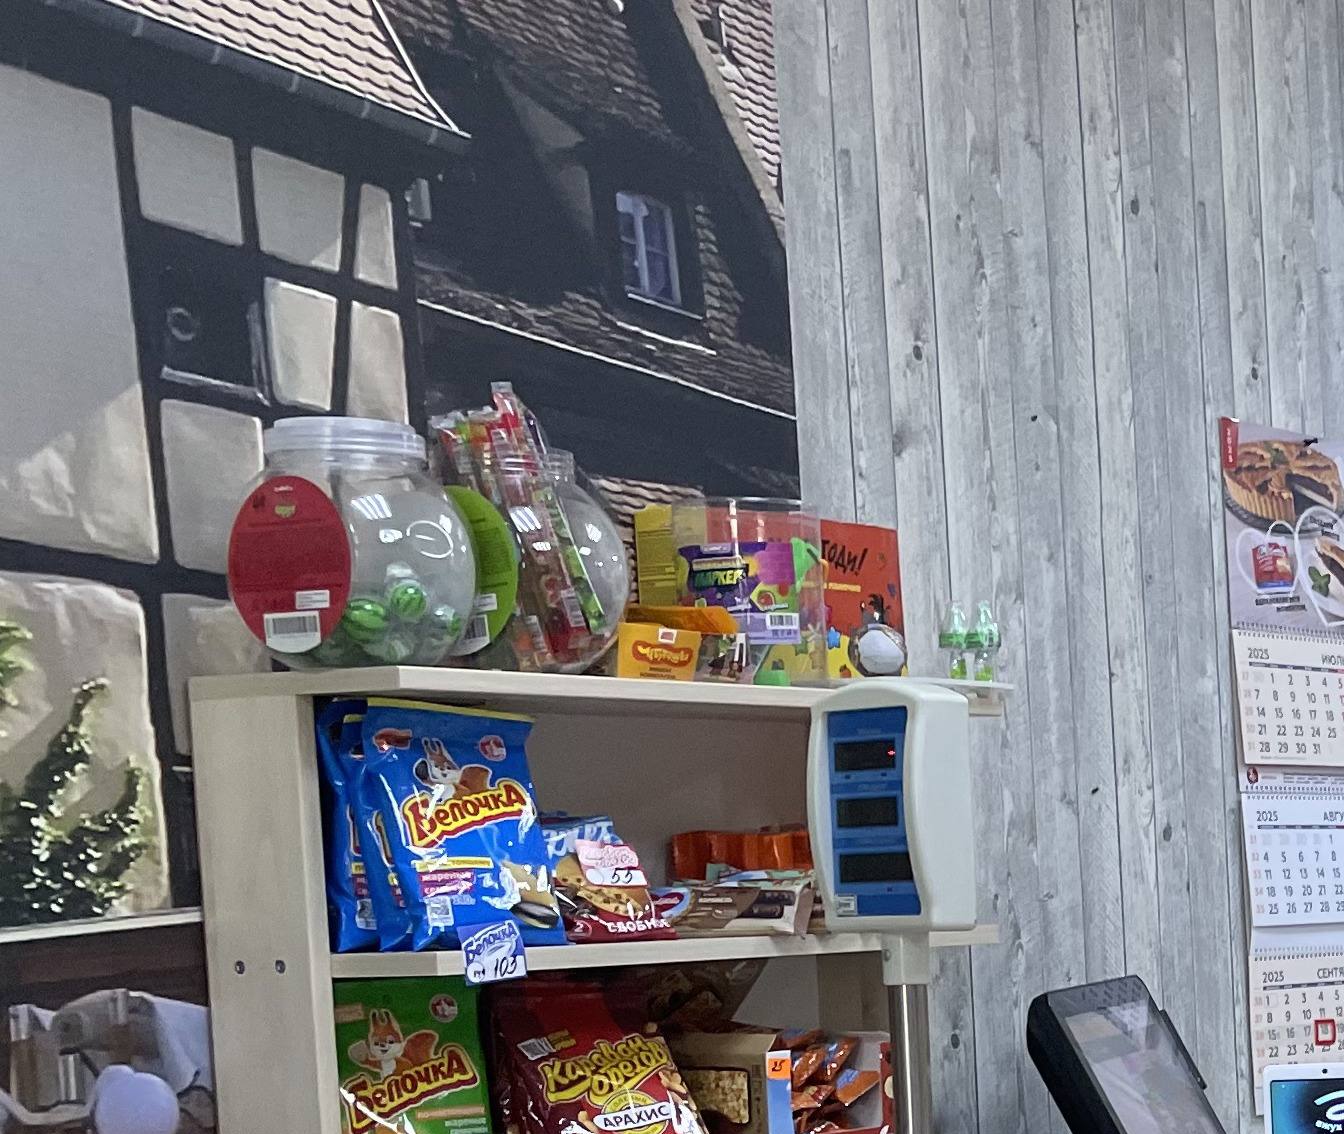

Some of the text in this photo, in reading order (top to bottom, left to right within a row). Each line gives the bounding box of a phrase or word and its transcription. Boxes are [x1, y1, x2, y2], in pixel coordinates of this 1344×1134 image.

[1248, 648, 1270, 660] 2025
[1257, 811, 1278, 822] 2025
[1266, 886, 1276, 897] 18
[1284, 886, 1293, 896] 19
[1302, 885, 1312, 896] 20
[1318, 885, 1326, 895] 21
[1335, 885, 1343, 895] 22
[1268, 904, 1279, 914] 25
[1287, 903, 1297, 914] 26
[1303, 902, 1313, 913] 27
[1320, 902, 1330, 912] 28
[1336, 901, 1344, 911] 29
[1262, 971, 1285, 984] 2025
[603, 1105, 671, 1128] АРАХИС
